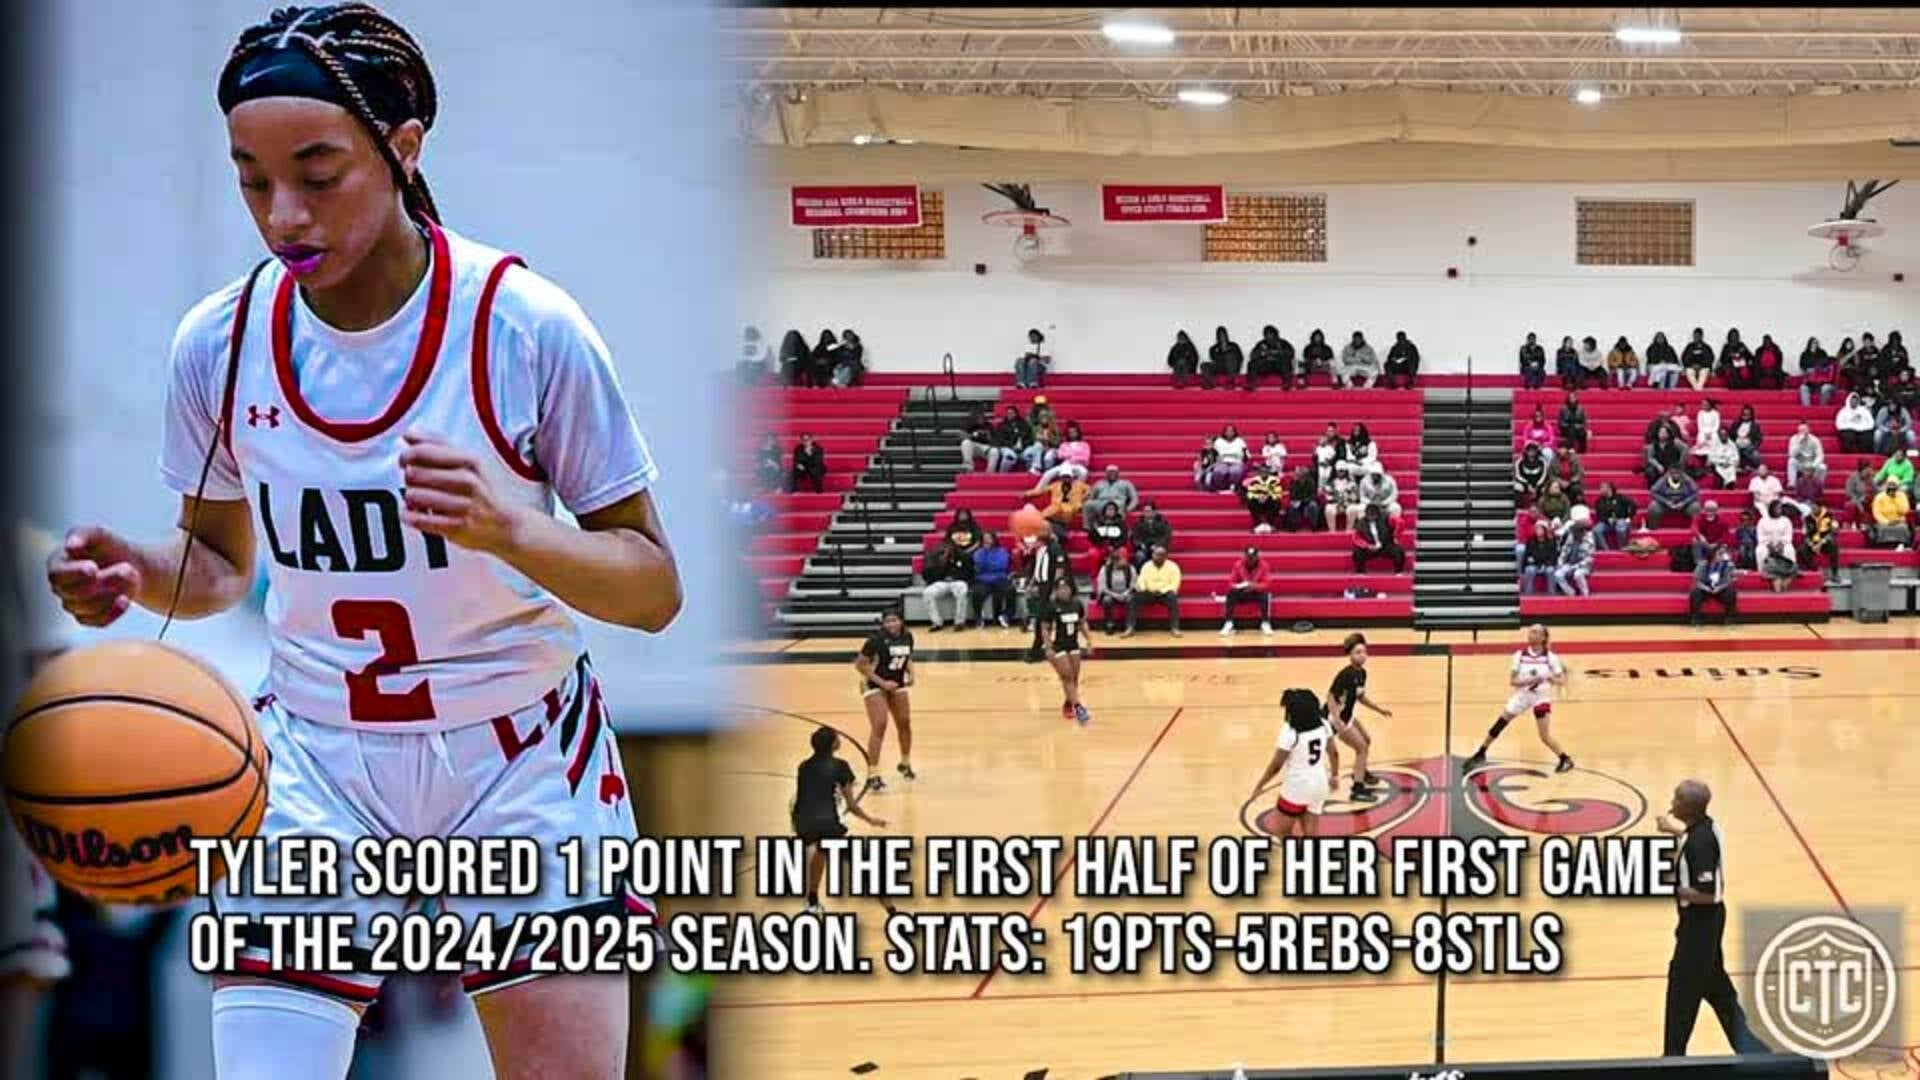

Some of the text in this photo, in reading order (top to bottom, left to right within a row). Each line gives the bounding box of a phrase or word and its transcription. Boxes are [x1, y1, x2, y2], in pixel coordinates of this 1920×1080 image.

[331, 599, 437, 722] 2
[1584, 665, 1822, 682] Saints
[1308, 738, 1321, 766] 5
[24, 815, 198, 867] Wilson
